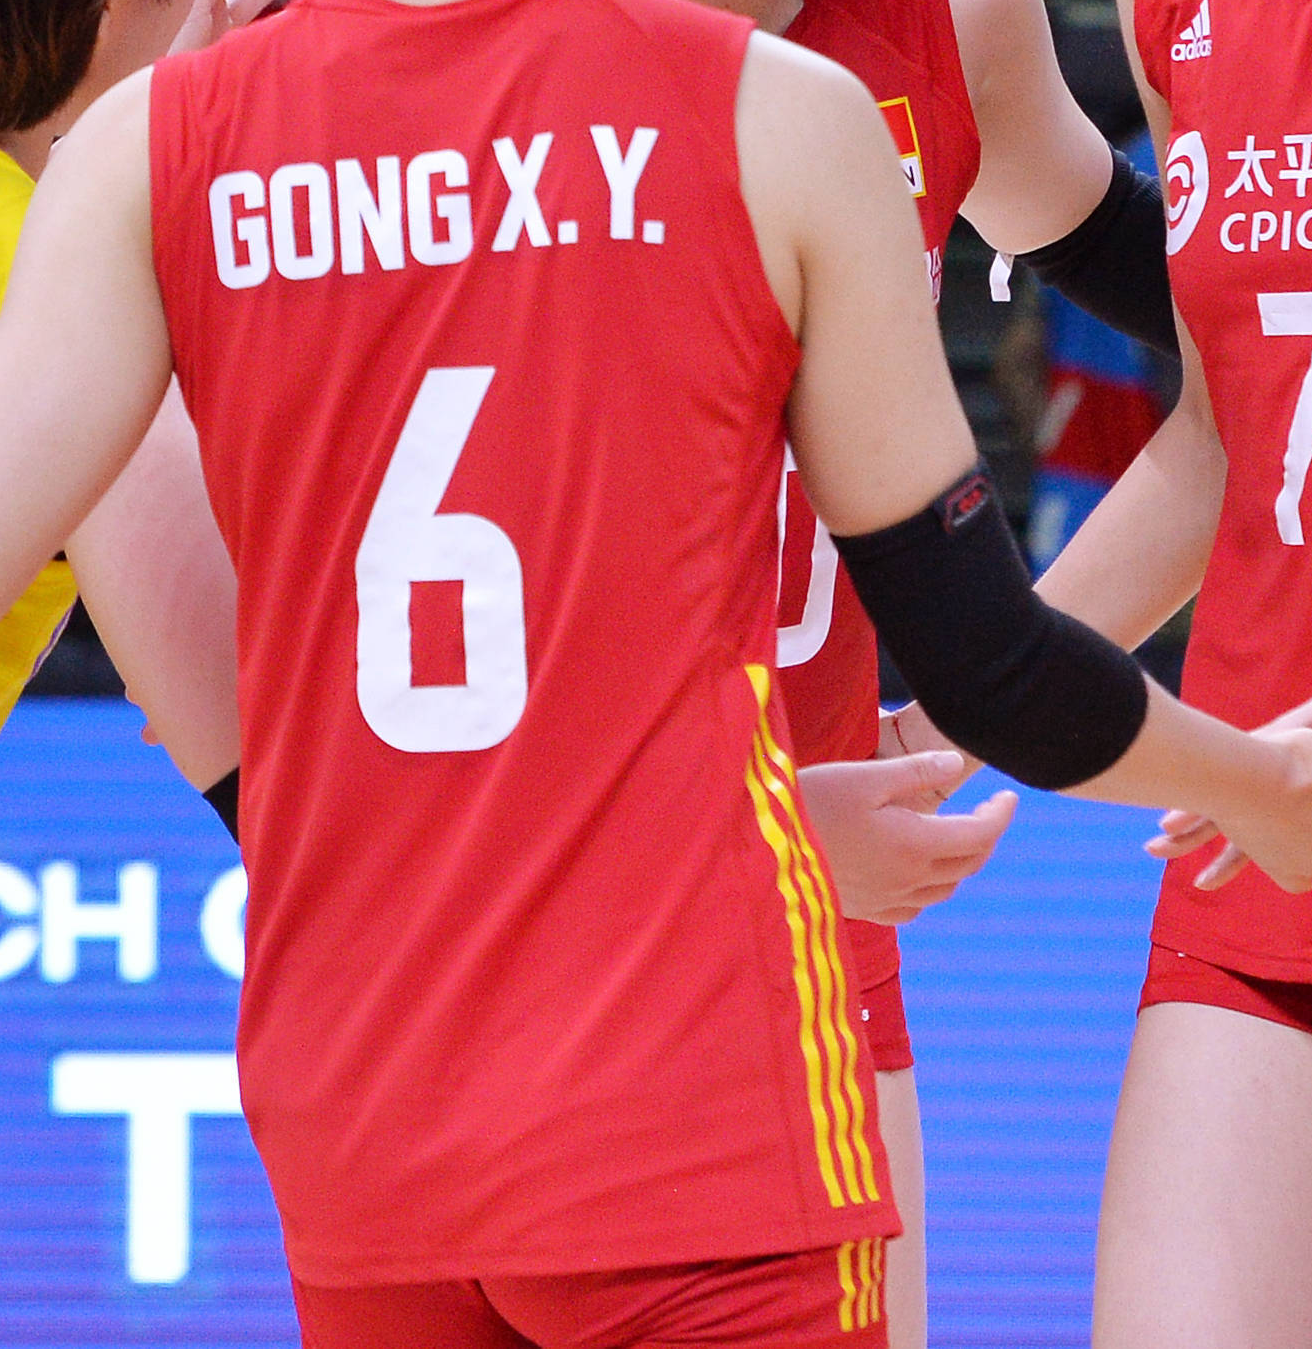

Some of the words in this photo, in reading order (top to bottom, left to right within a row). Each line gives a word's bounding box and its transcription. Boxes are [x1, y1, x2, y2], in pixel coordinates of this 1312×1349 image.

[207, 149, 475, 290] GONG
[491, 132, 579, 253] X.
[590, 124, 665, 244] Y.
[355, 365, 530, 754] 6
